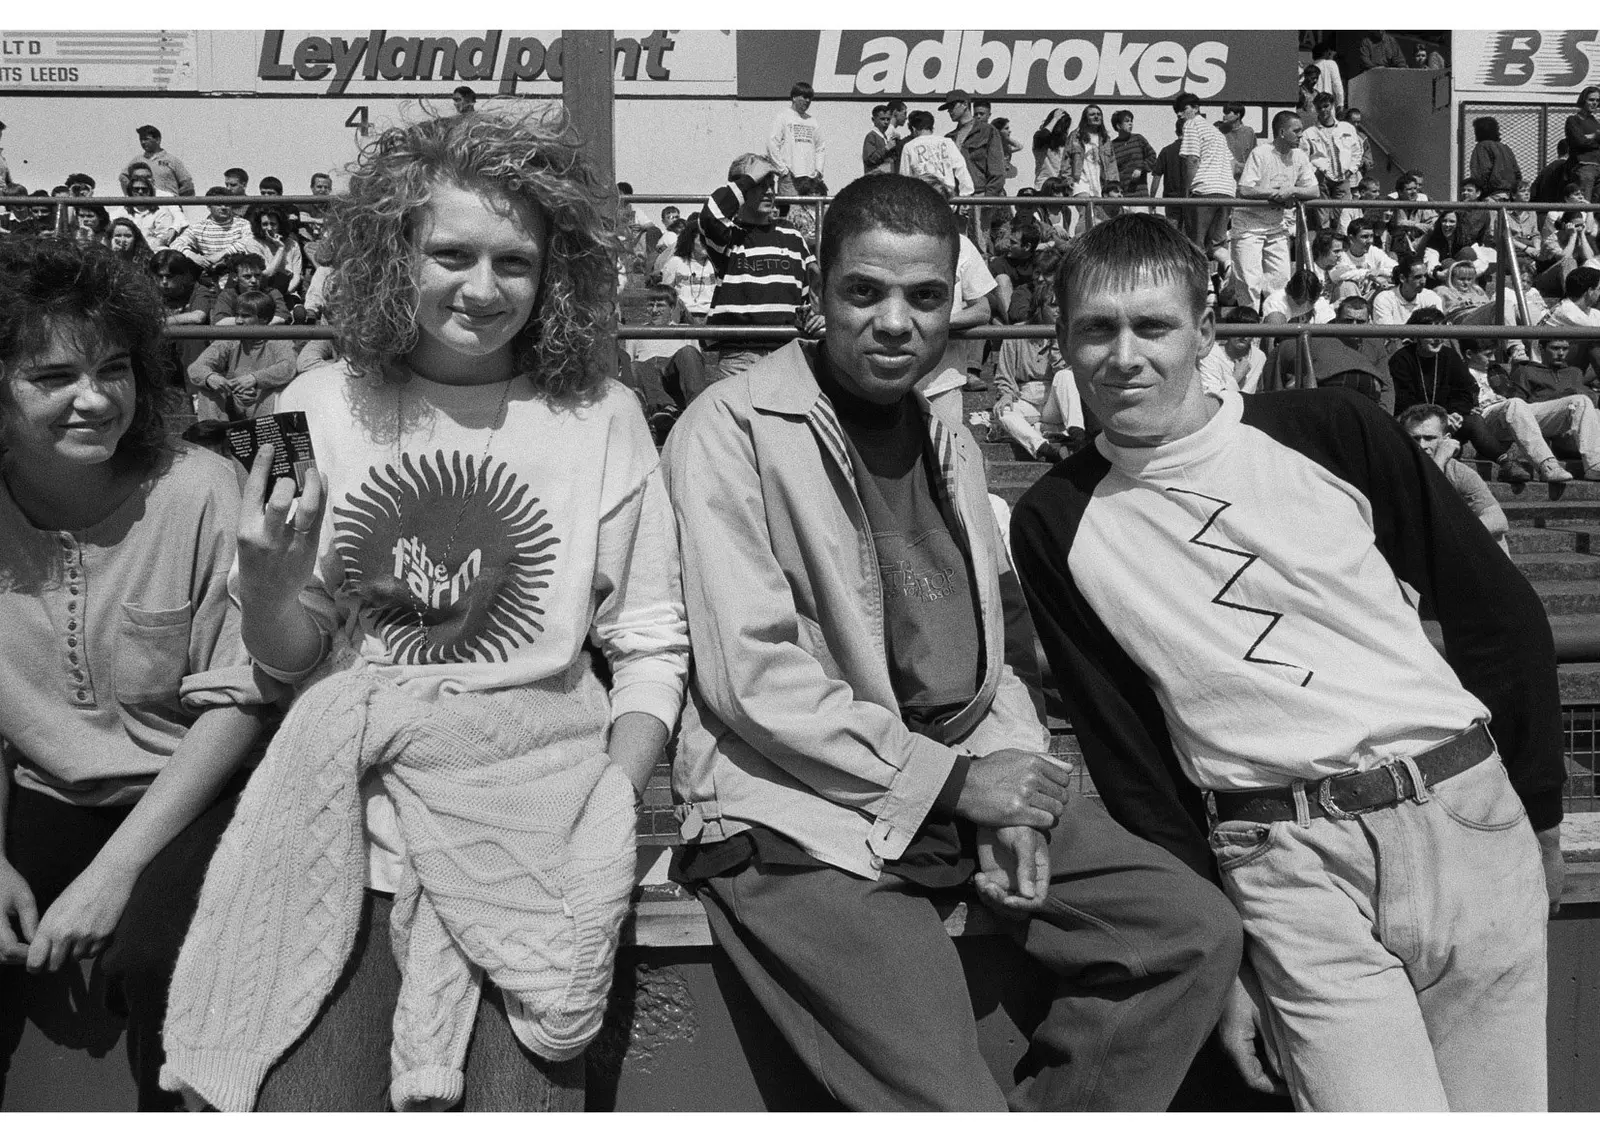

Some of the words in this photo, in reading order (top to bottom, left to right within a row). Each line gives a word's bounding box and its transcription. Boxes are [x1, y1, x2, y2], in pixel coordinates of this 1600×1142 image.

[3, 40, 41, 54] LTD
[257, 30, 502, 94] Leyland
[498, 30, 676, 95] pnt
[812, 30, 1229, 98] Ladbrokes
[1476, 30, 1600, 87] BS
[31, 67, 78, 82] LEEDS
[345, 106, 373, 136] 4
[392, 538, 482, 610] farm
[410, 536, 449, 582] the
